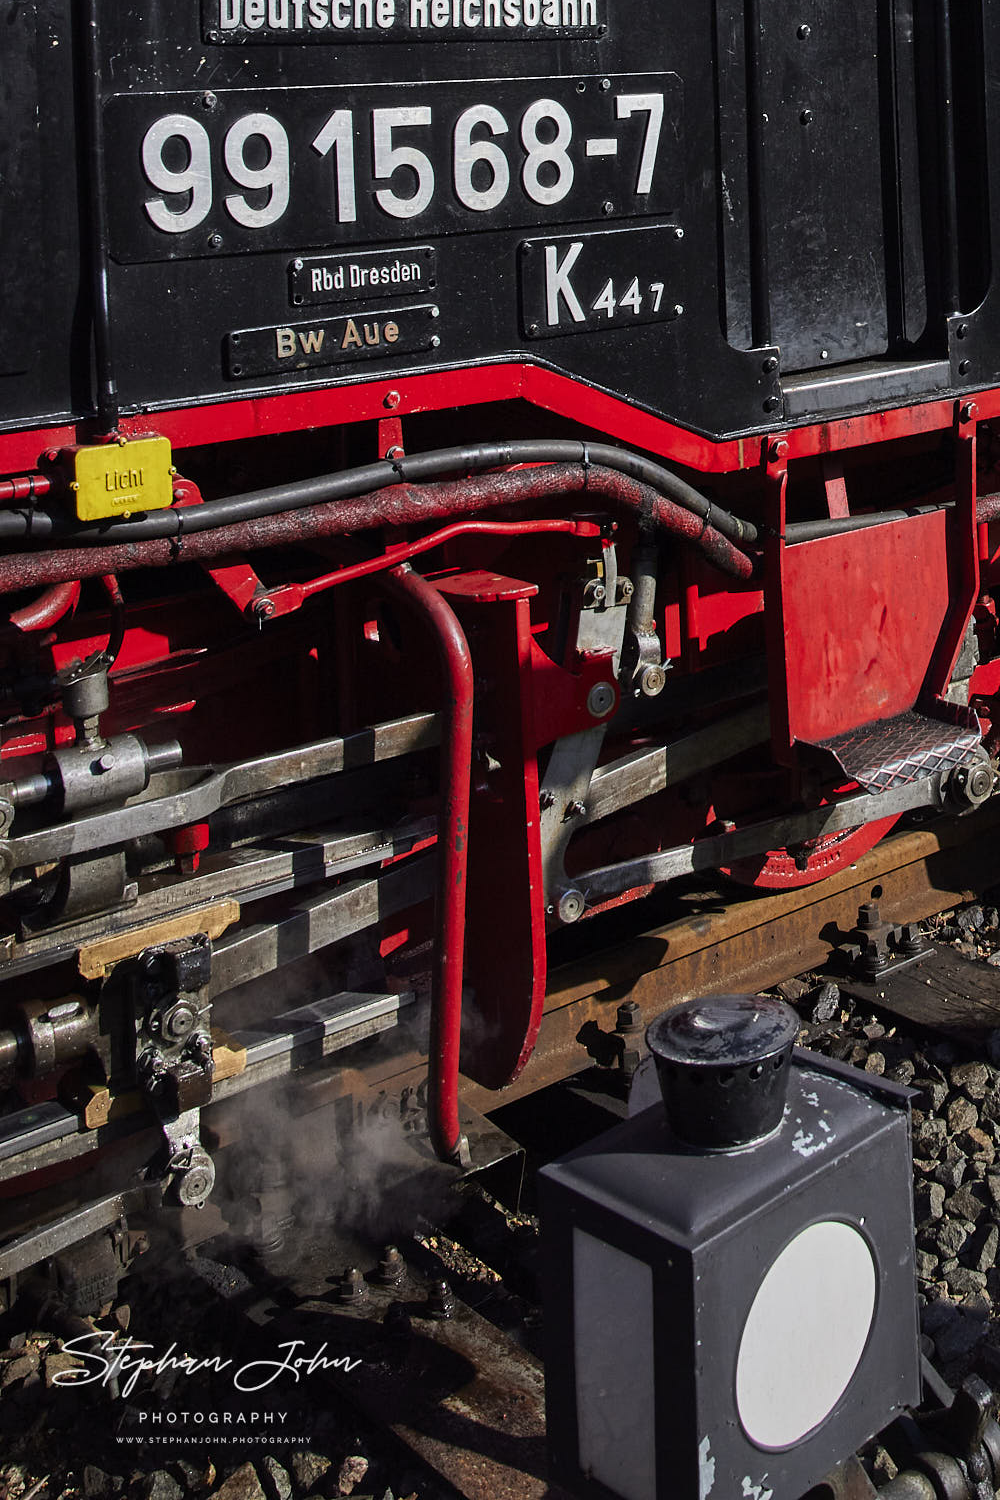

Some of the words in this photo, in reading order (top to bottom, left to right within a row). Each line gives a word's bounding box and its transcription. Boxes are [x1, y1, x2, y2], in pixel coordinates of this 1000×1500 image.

[311, 266, 344, 292] Rbd
[350, 260, 421, 288] Dresden
[276, 328, 325, 359] Bw
[341, 318, 399, 349] Aue
[105, 467, 145, 492] Licht
